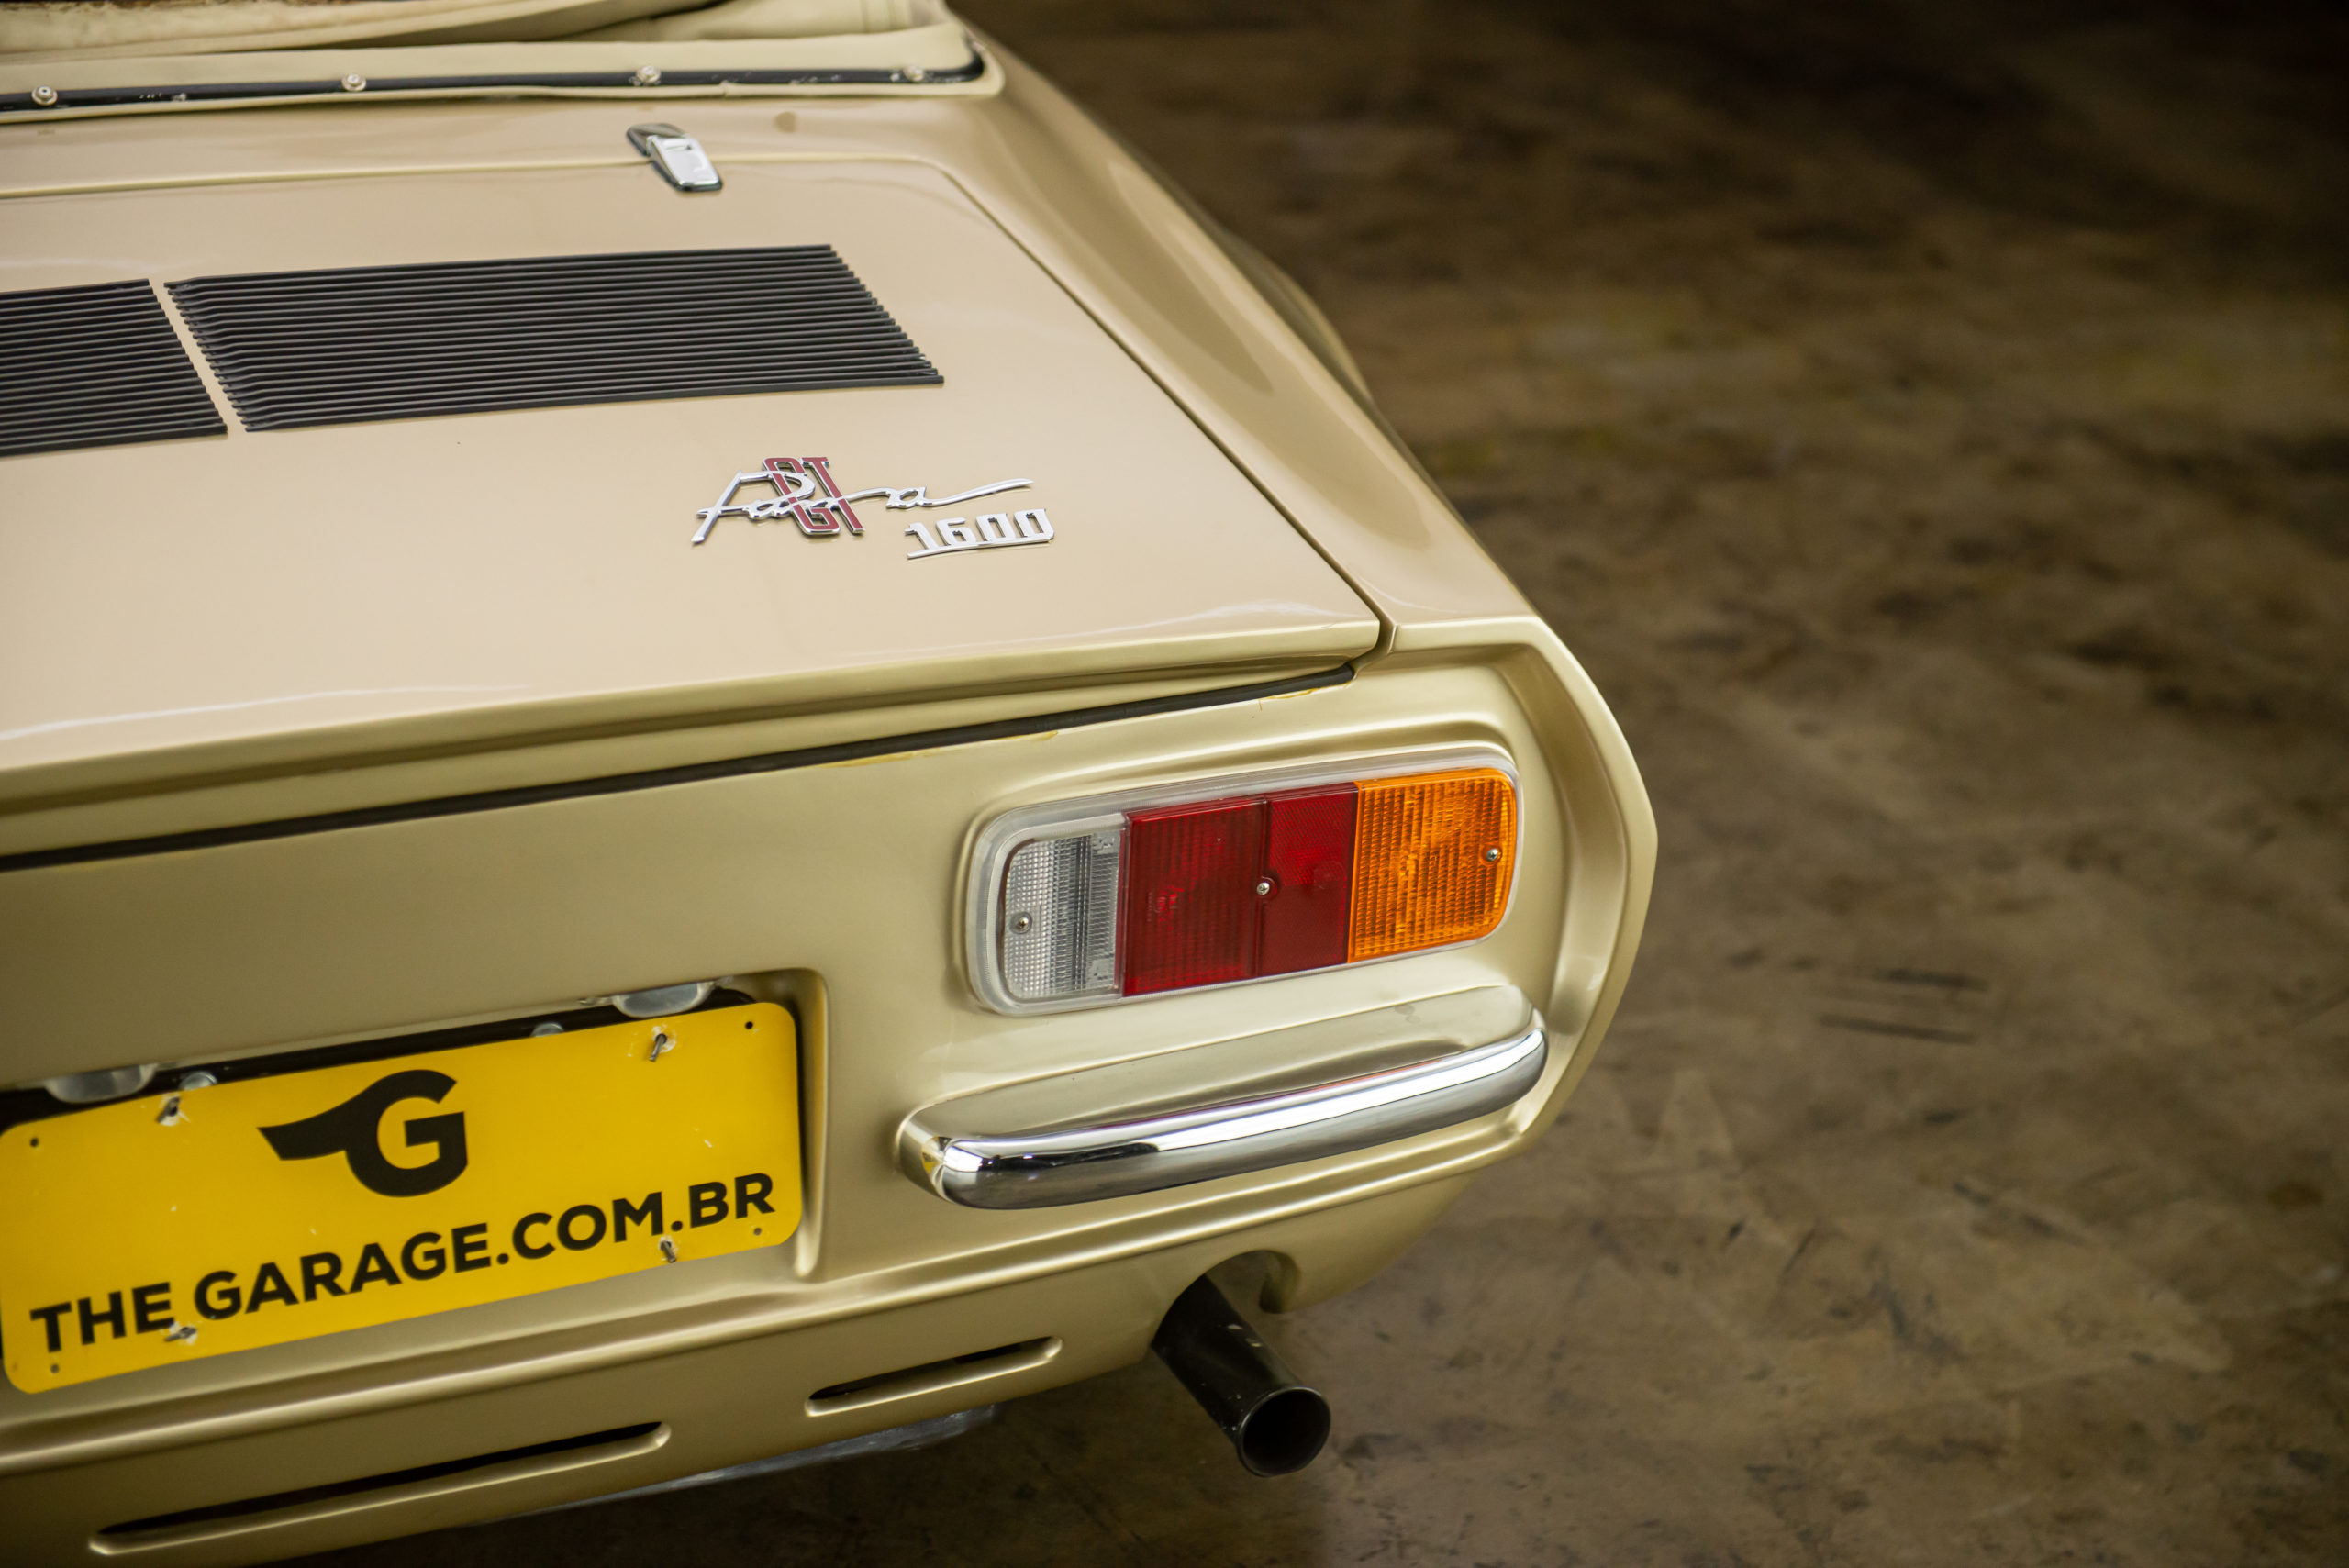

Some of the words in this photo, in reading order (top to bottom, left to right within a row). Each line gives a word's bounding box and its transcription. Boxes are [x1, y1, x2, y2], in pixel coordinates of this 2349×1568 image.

[904, 507, 1056, 558] 1600
[29, 1281, 175, 1353] THE
[194, 1172, 775, 1321] GARAGE.COM.BR
